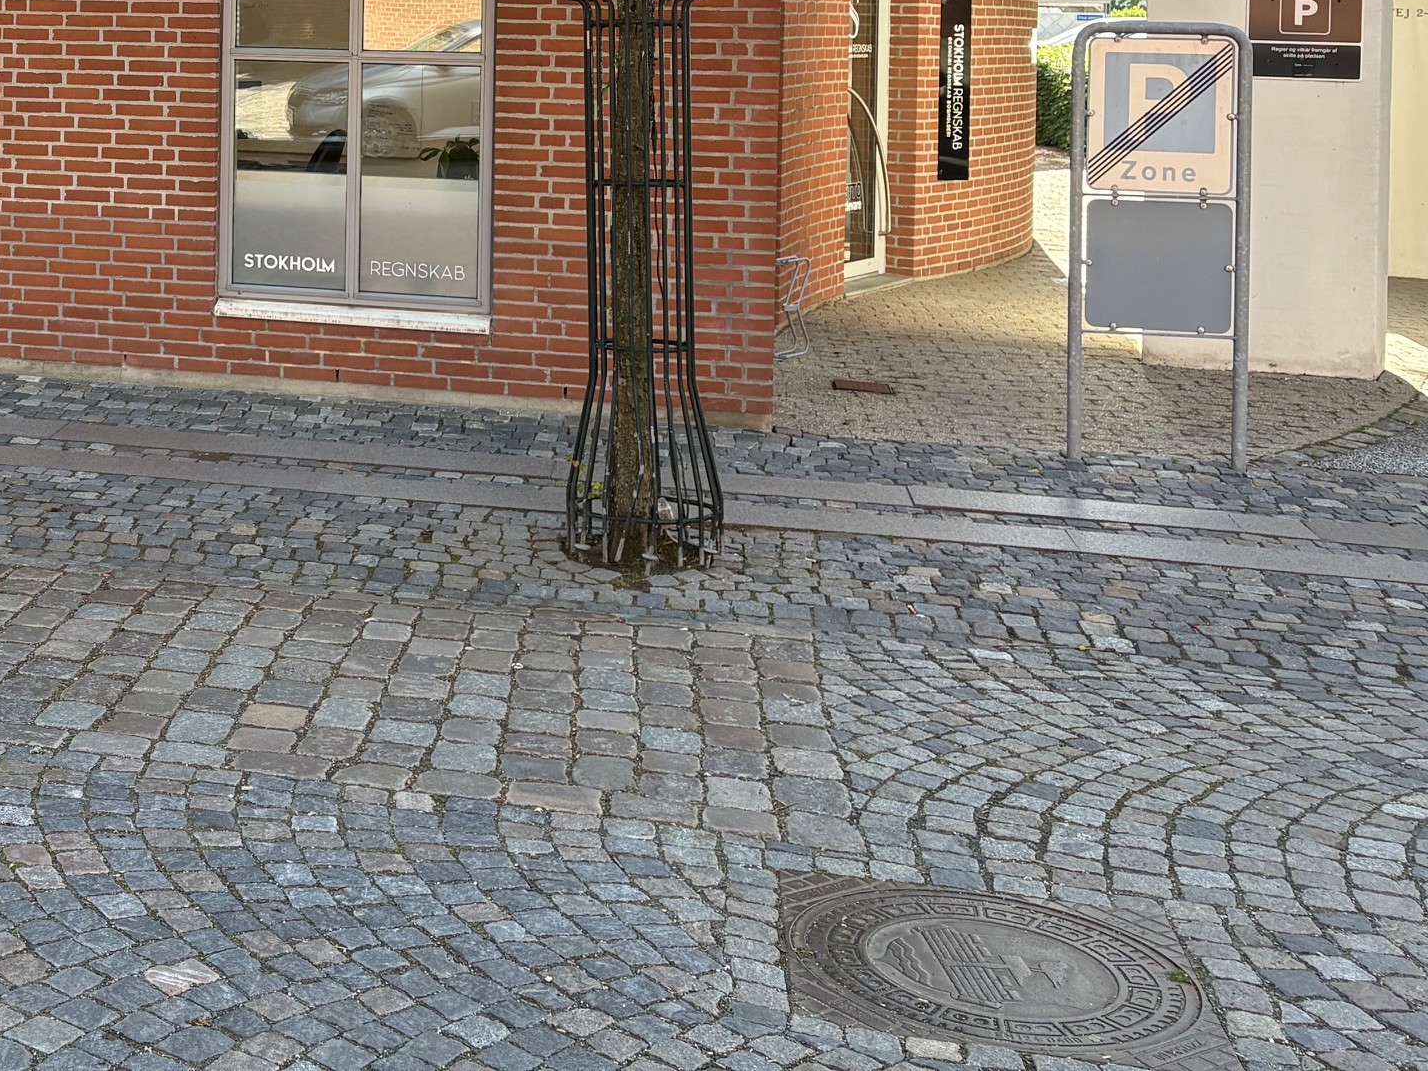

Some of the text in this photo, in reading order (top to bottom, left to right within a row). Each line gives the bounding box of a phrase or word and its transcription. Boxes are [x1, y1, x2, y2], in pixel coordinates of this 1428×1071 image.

[1393, 8, 1410, 19] EJ
[952, 24, 965, 150] STOKHOLM REGNSKAB
[1128, 63, 1190, 137] P
[1121, 161, 1196, 182] Zone
[244, 253, 466, 281] STOKHOLM REGNSKAB
